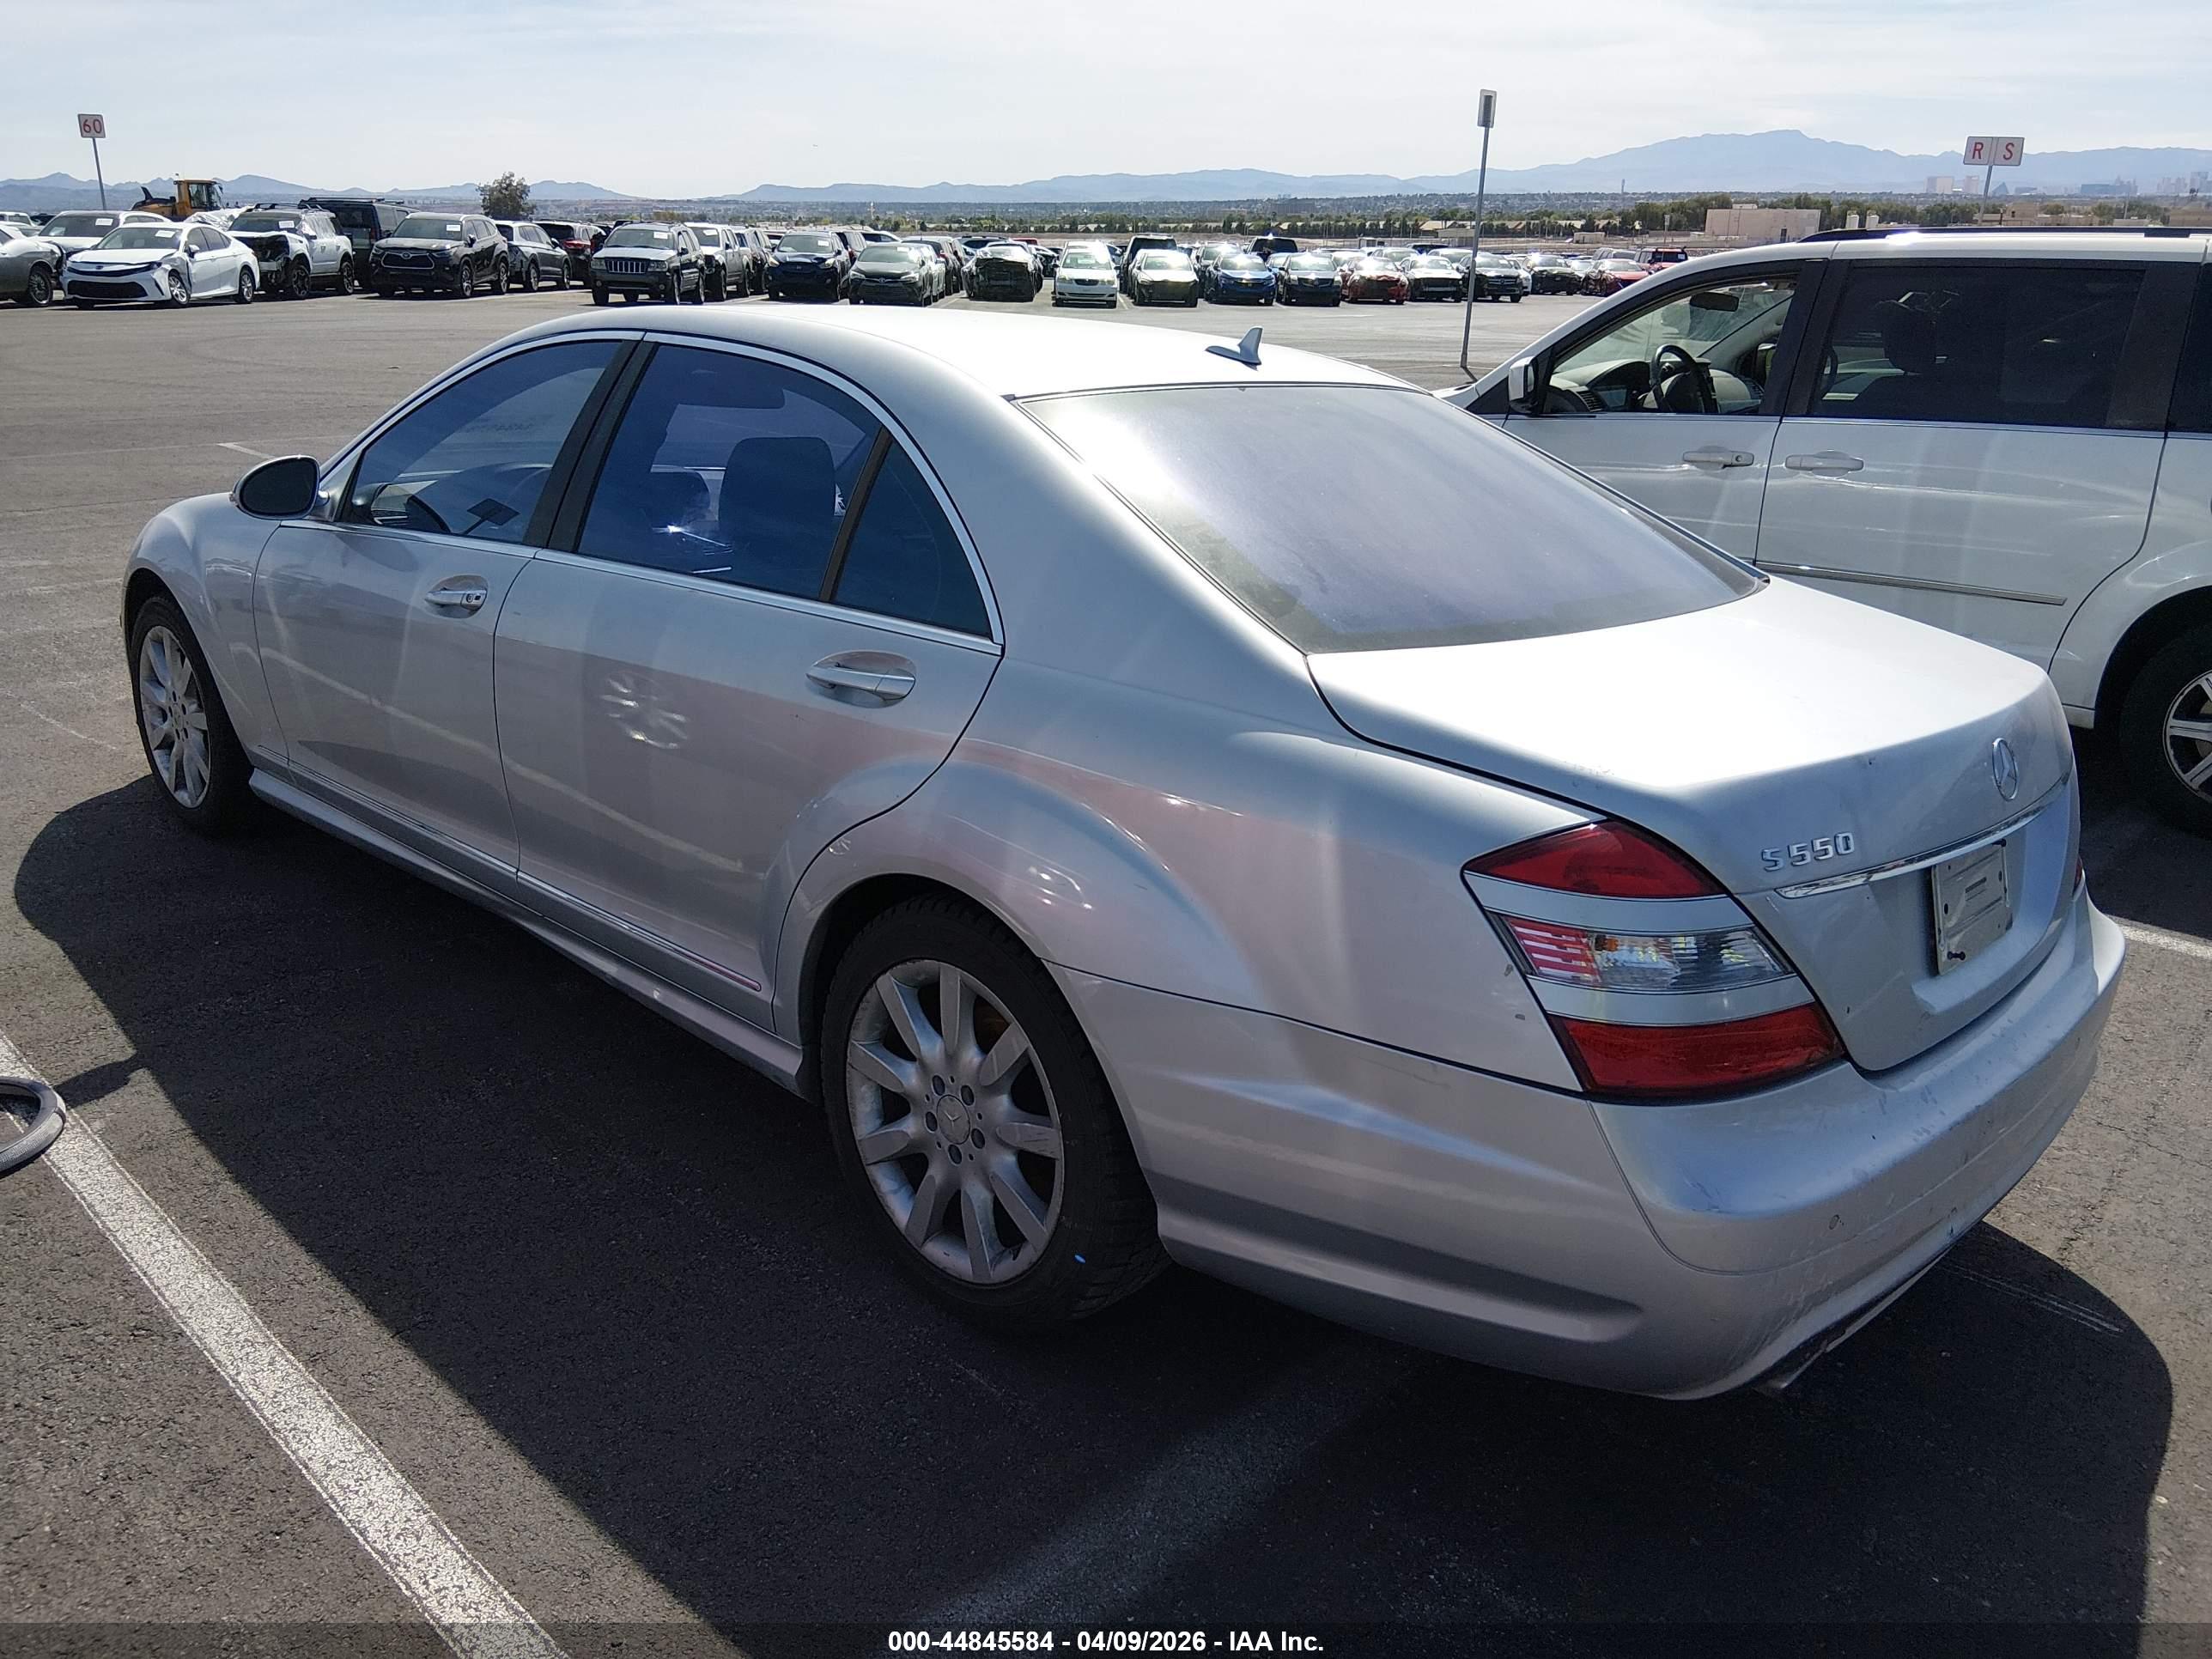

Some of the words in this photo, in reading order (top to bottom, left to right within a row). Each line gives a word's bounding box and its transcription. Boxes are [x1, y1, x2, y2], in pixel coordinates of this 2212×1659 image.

[82, 118, 102, 134] 60
[1972, 142, 1984, 160] R
[2002, 142, 2014, 161] S
